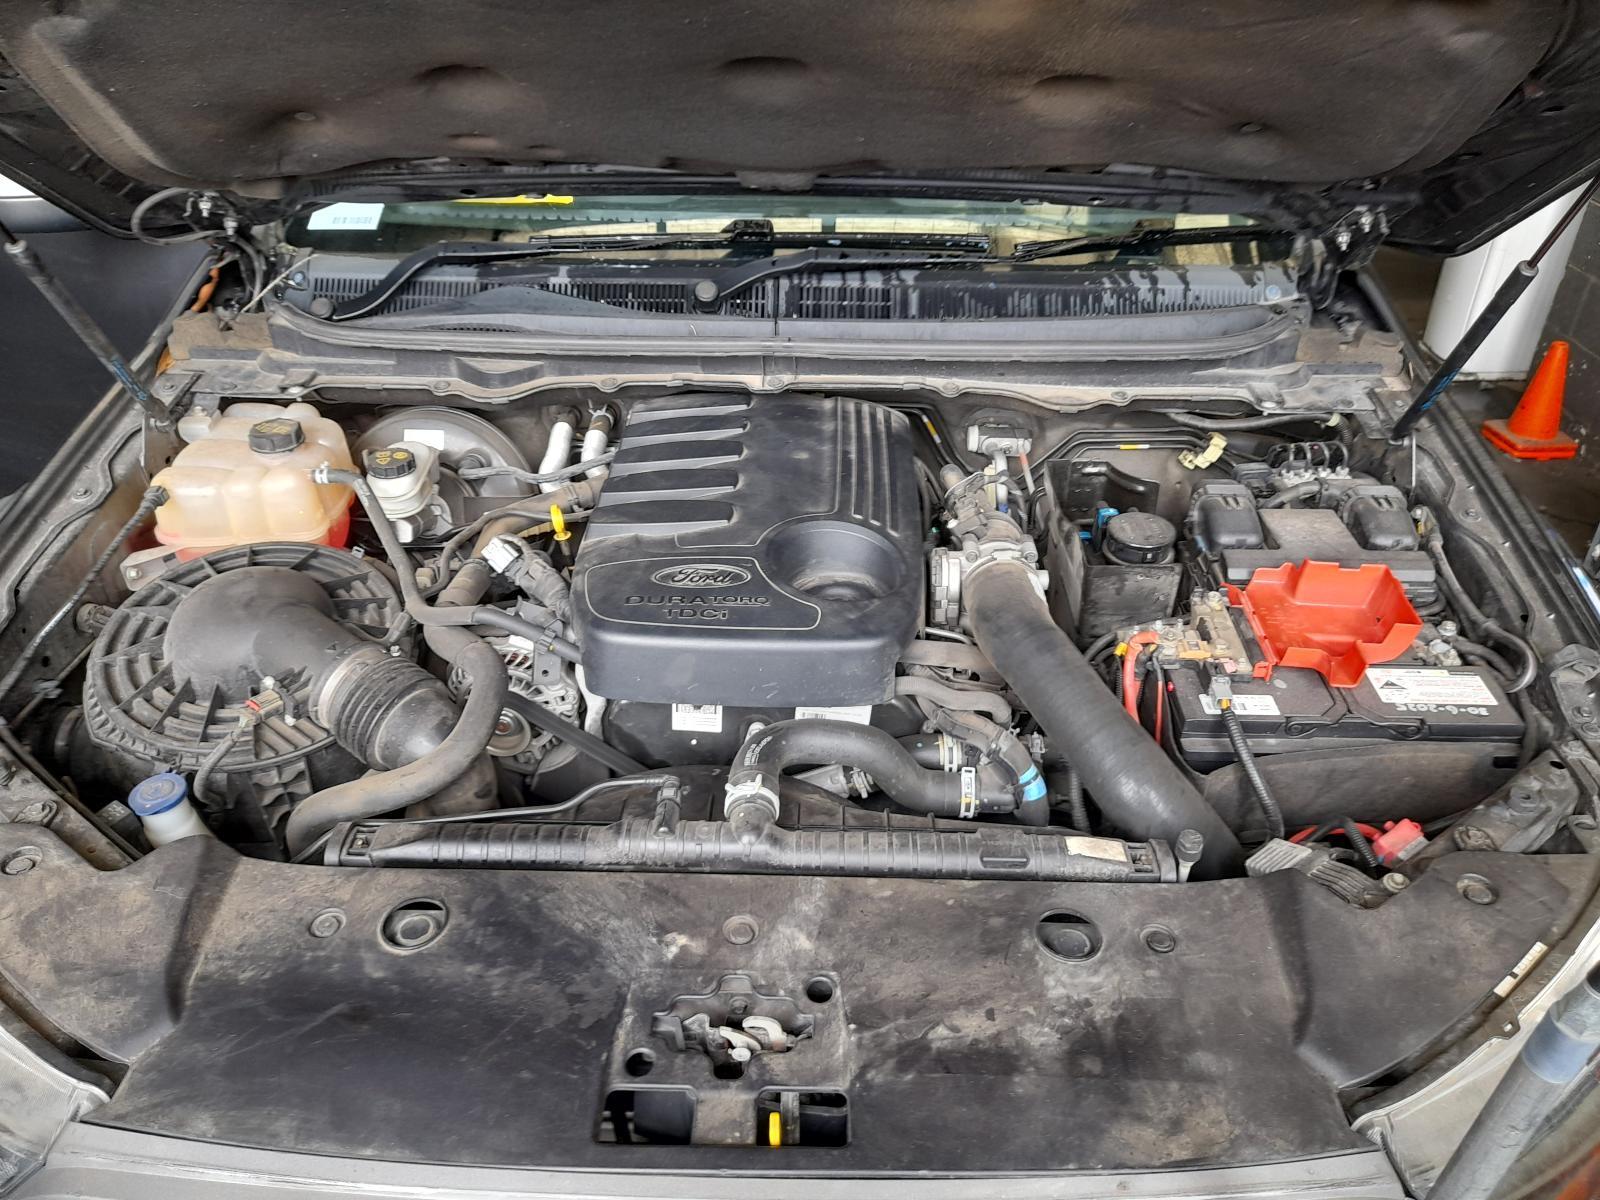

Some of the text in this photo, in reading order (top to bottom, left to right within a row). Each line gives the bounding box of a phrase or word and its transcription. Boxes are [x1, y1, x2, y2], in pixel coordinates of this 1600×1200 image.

[671, 567, 735, 586] Ford
[624, 595, 770, 607] DURATORQ
[663, 608, 729, 620] TDCi
